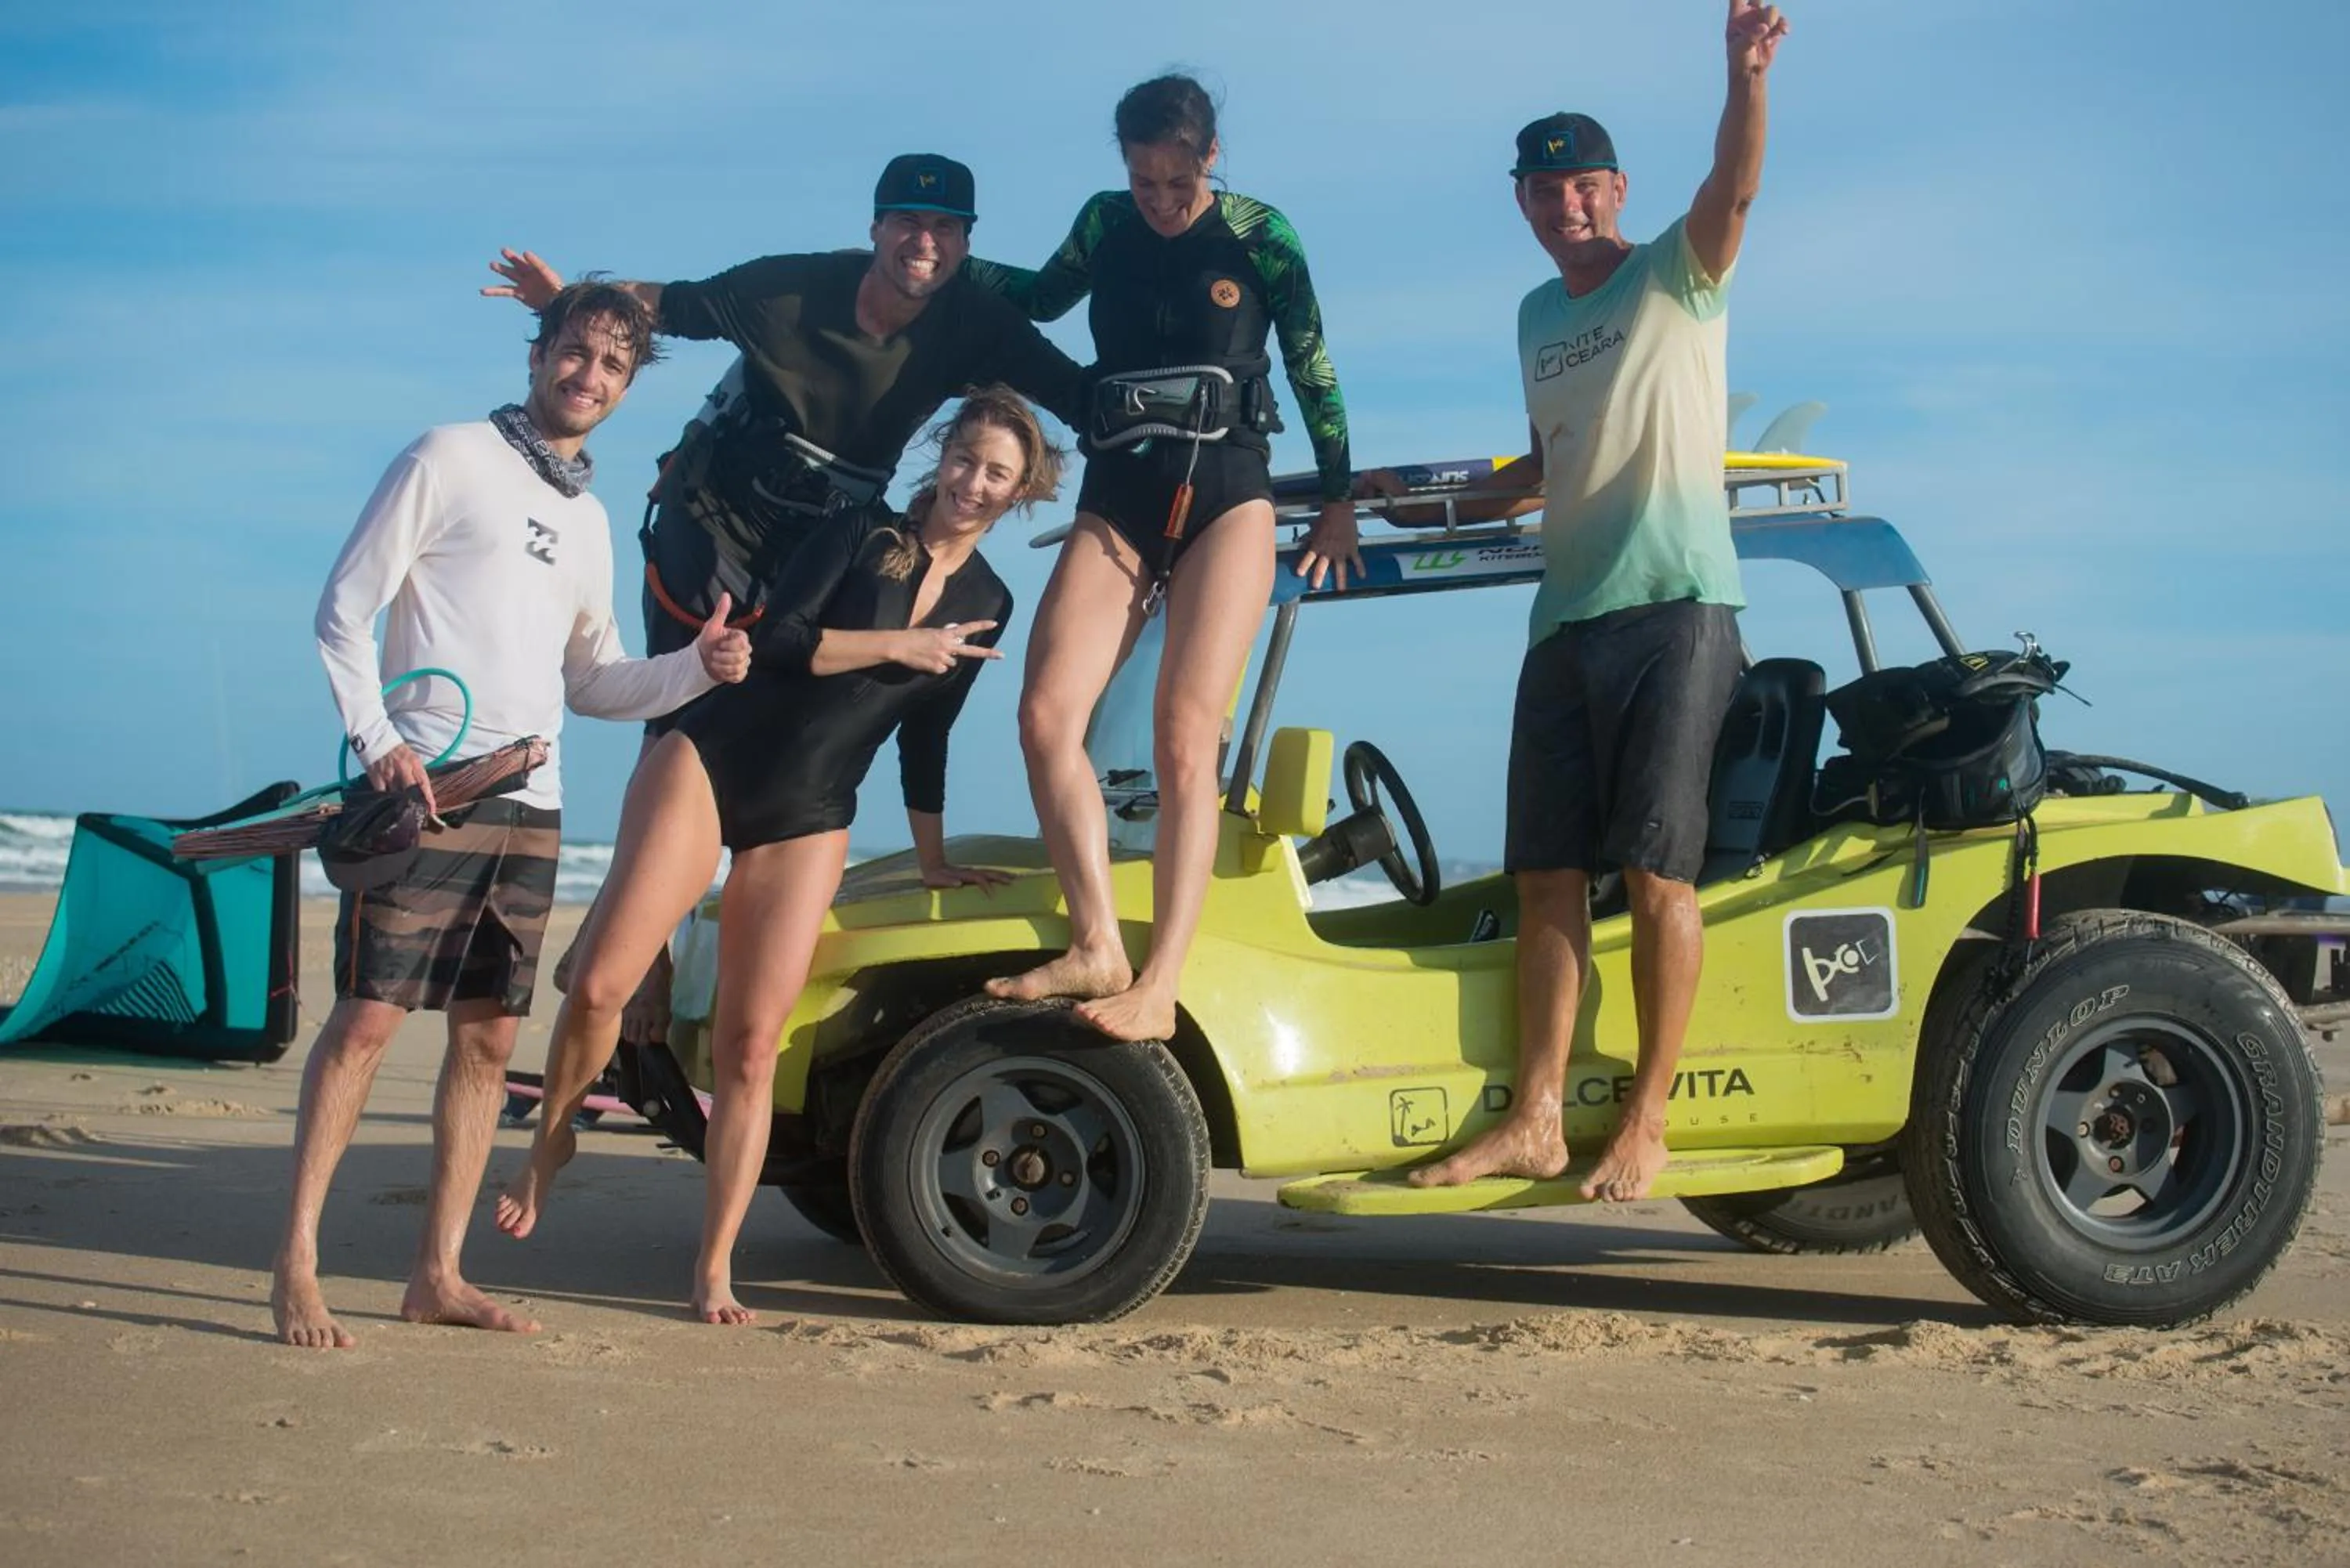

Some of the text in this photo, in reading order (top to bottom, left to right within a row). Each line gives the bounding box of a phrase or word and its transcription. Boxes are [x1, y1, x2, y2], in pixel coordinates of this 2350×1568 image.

[1567, 329, 1625, 367] CEARA
[1483, 1075, 1636, 1113] DCE
[2006, 985, 2130, 1154] DUNLOP
[2189, 1031, 2285, 1272] GRANDTREK
